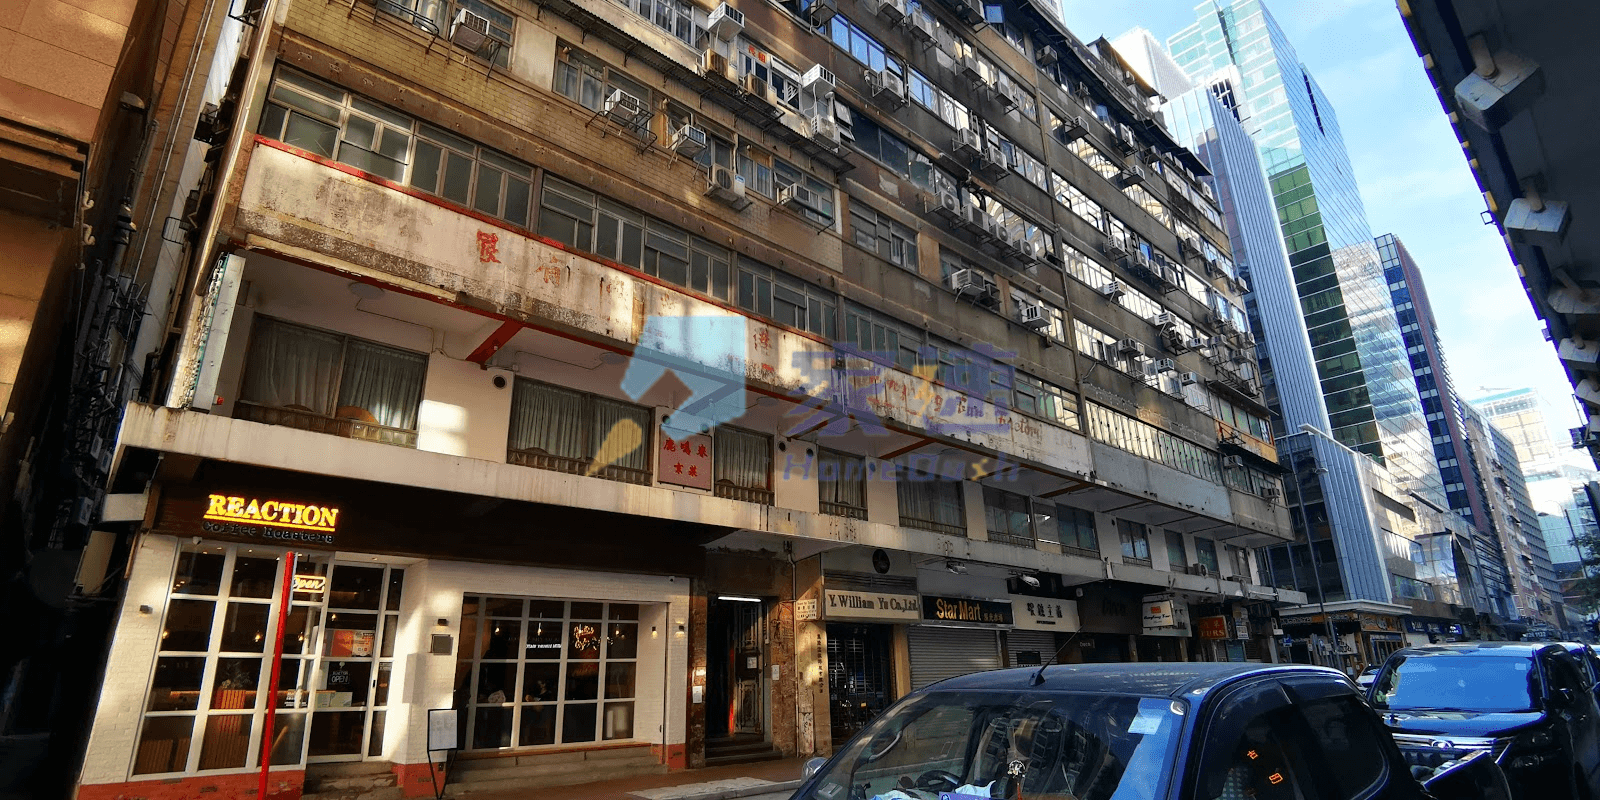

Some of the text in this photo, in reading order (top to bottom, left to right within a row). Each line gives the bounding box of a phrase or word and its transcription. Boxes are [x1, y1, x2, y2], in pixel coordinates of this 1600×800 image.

[206, 493, 339, 528] REACTION
[202, 520, 335, 544] Coffee Roasters
[838, 594, 875, 610] William
[877, 597, 889, 610] Yu
[936, 598, 982, 622] Star Mart
